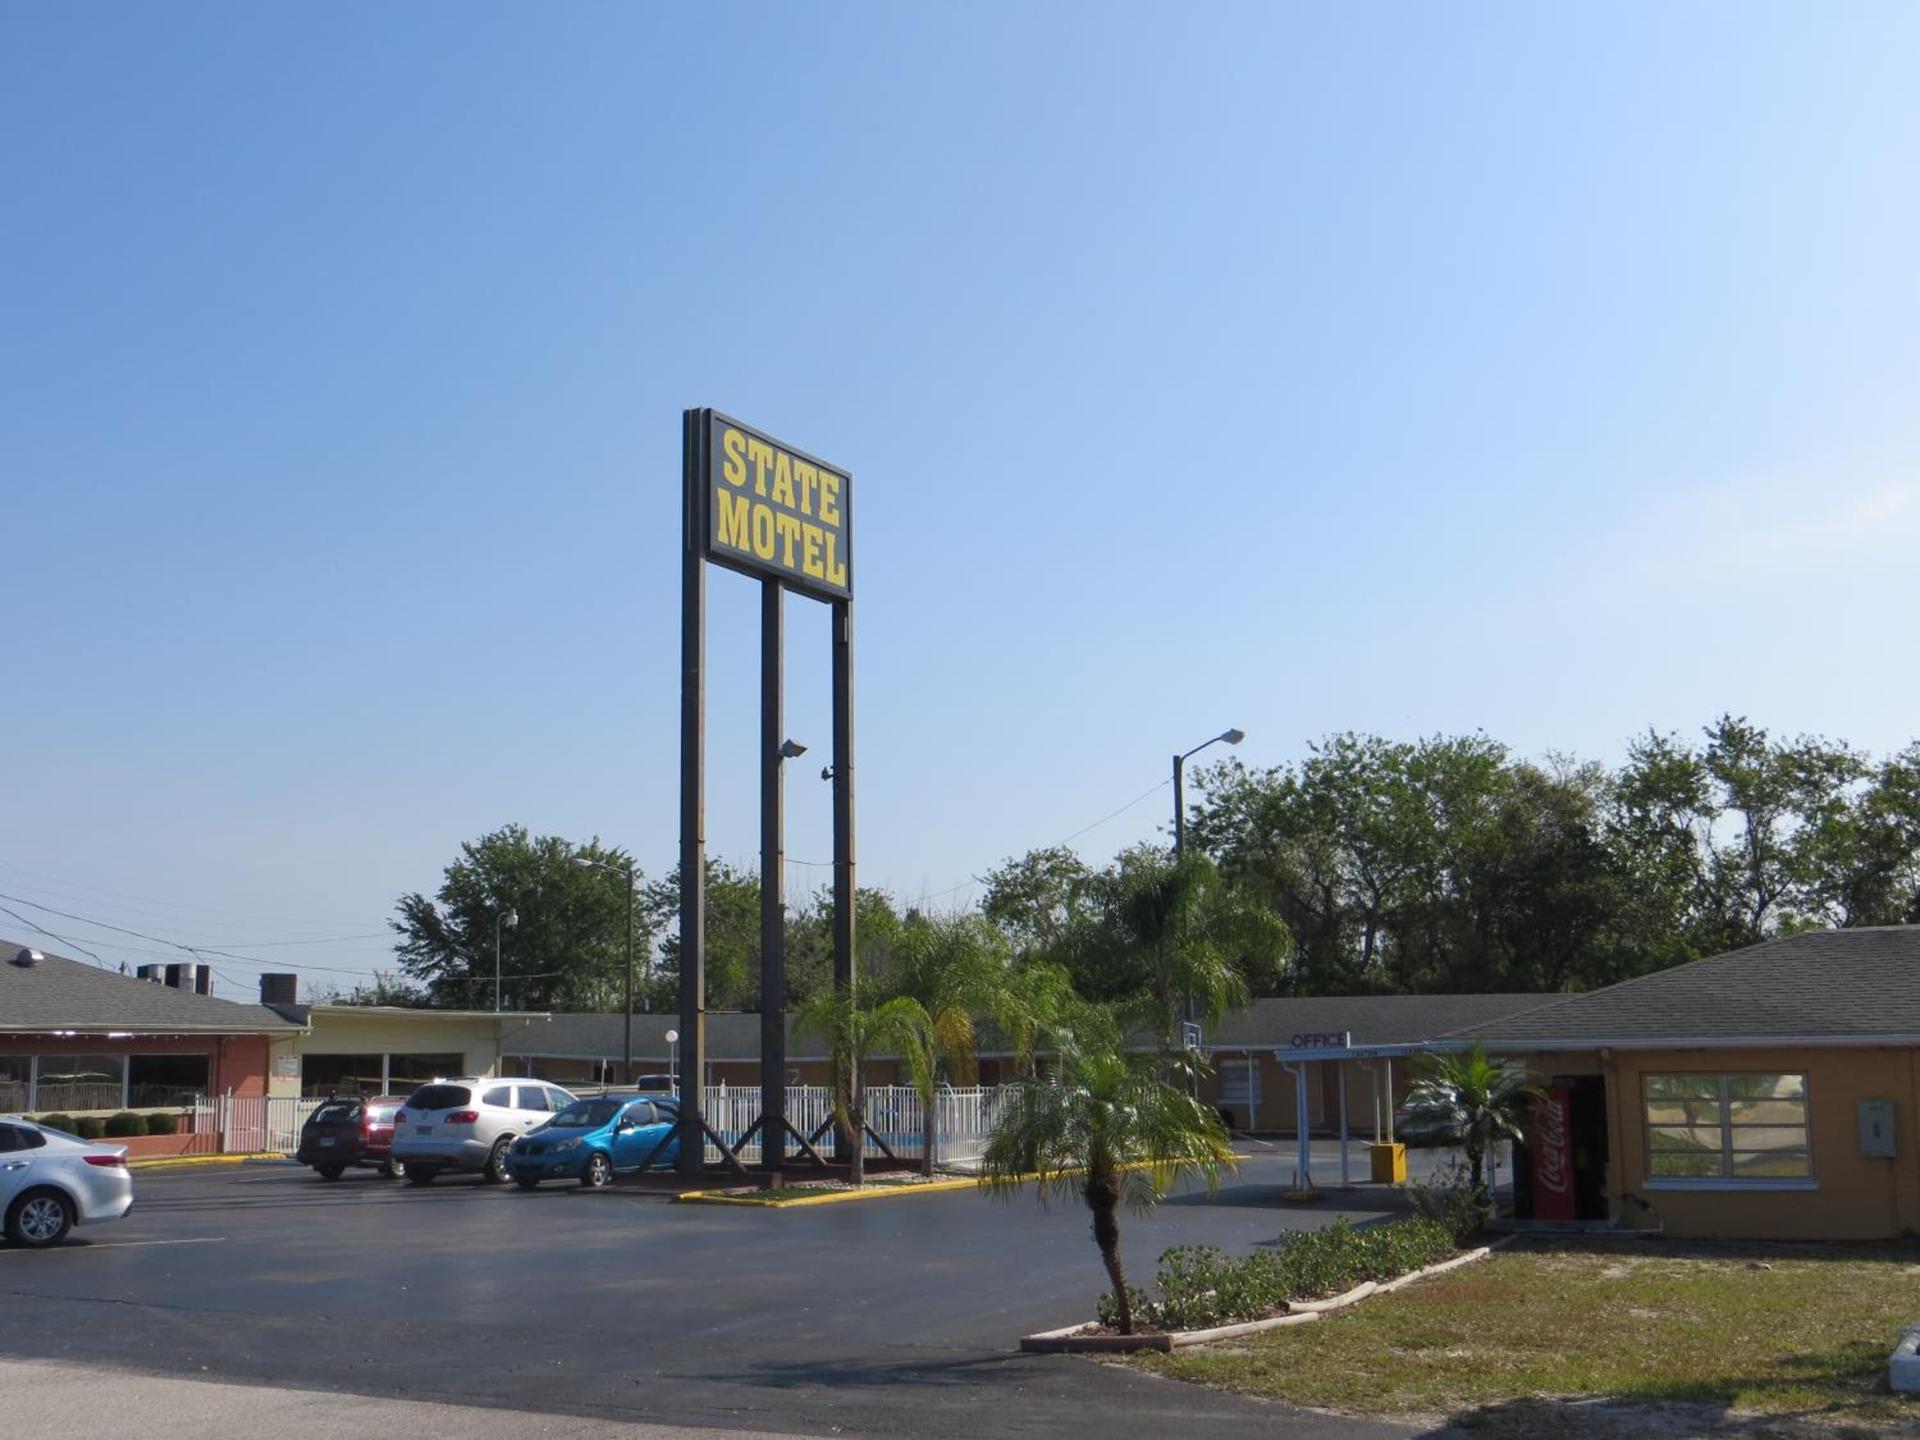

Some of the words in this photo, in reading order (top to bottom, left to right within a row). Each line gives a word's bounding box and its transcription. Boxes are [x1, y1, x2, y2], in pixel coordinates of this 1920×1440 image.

[723, 429, 840, 527] STATE
[717, 487, 846, 587] MOTEL
[1291, 1033, 1345, 1047] OFFICE
